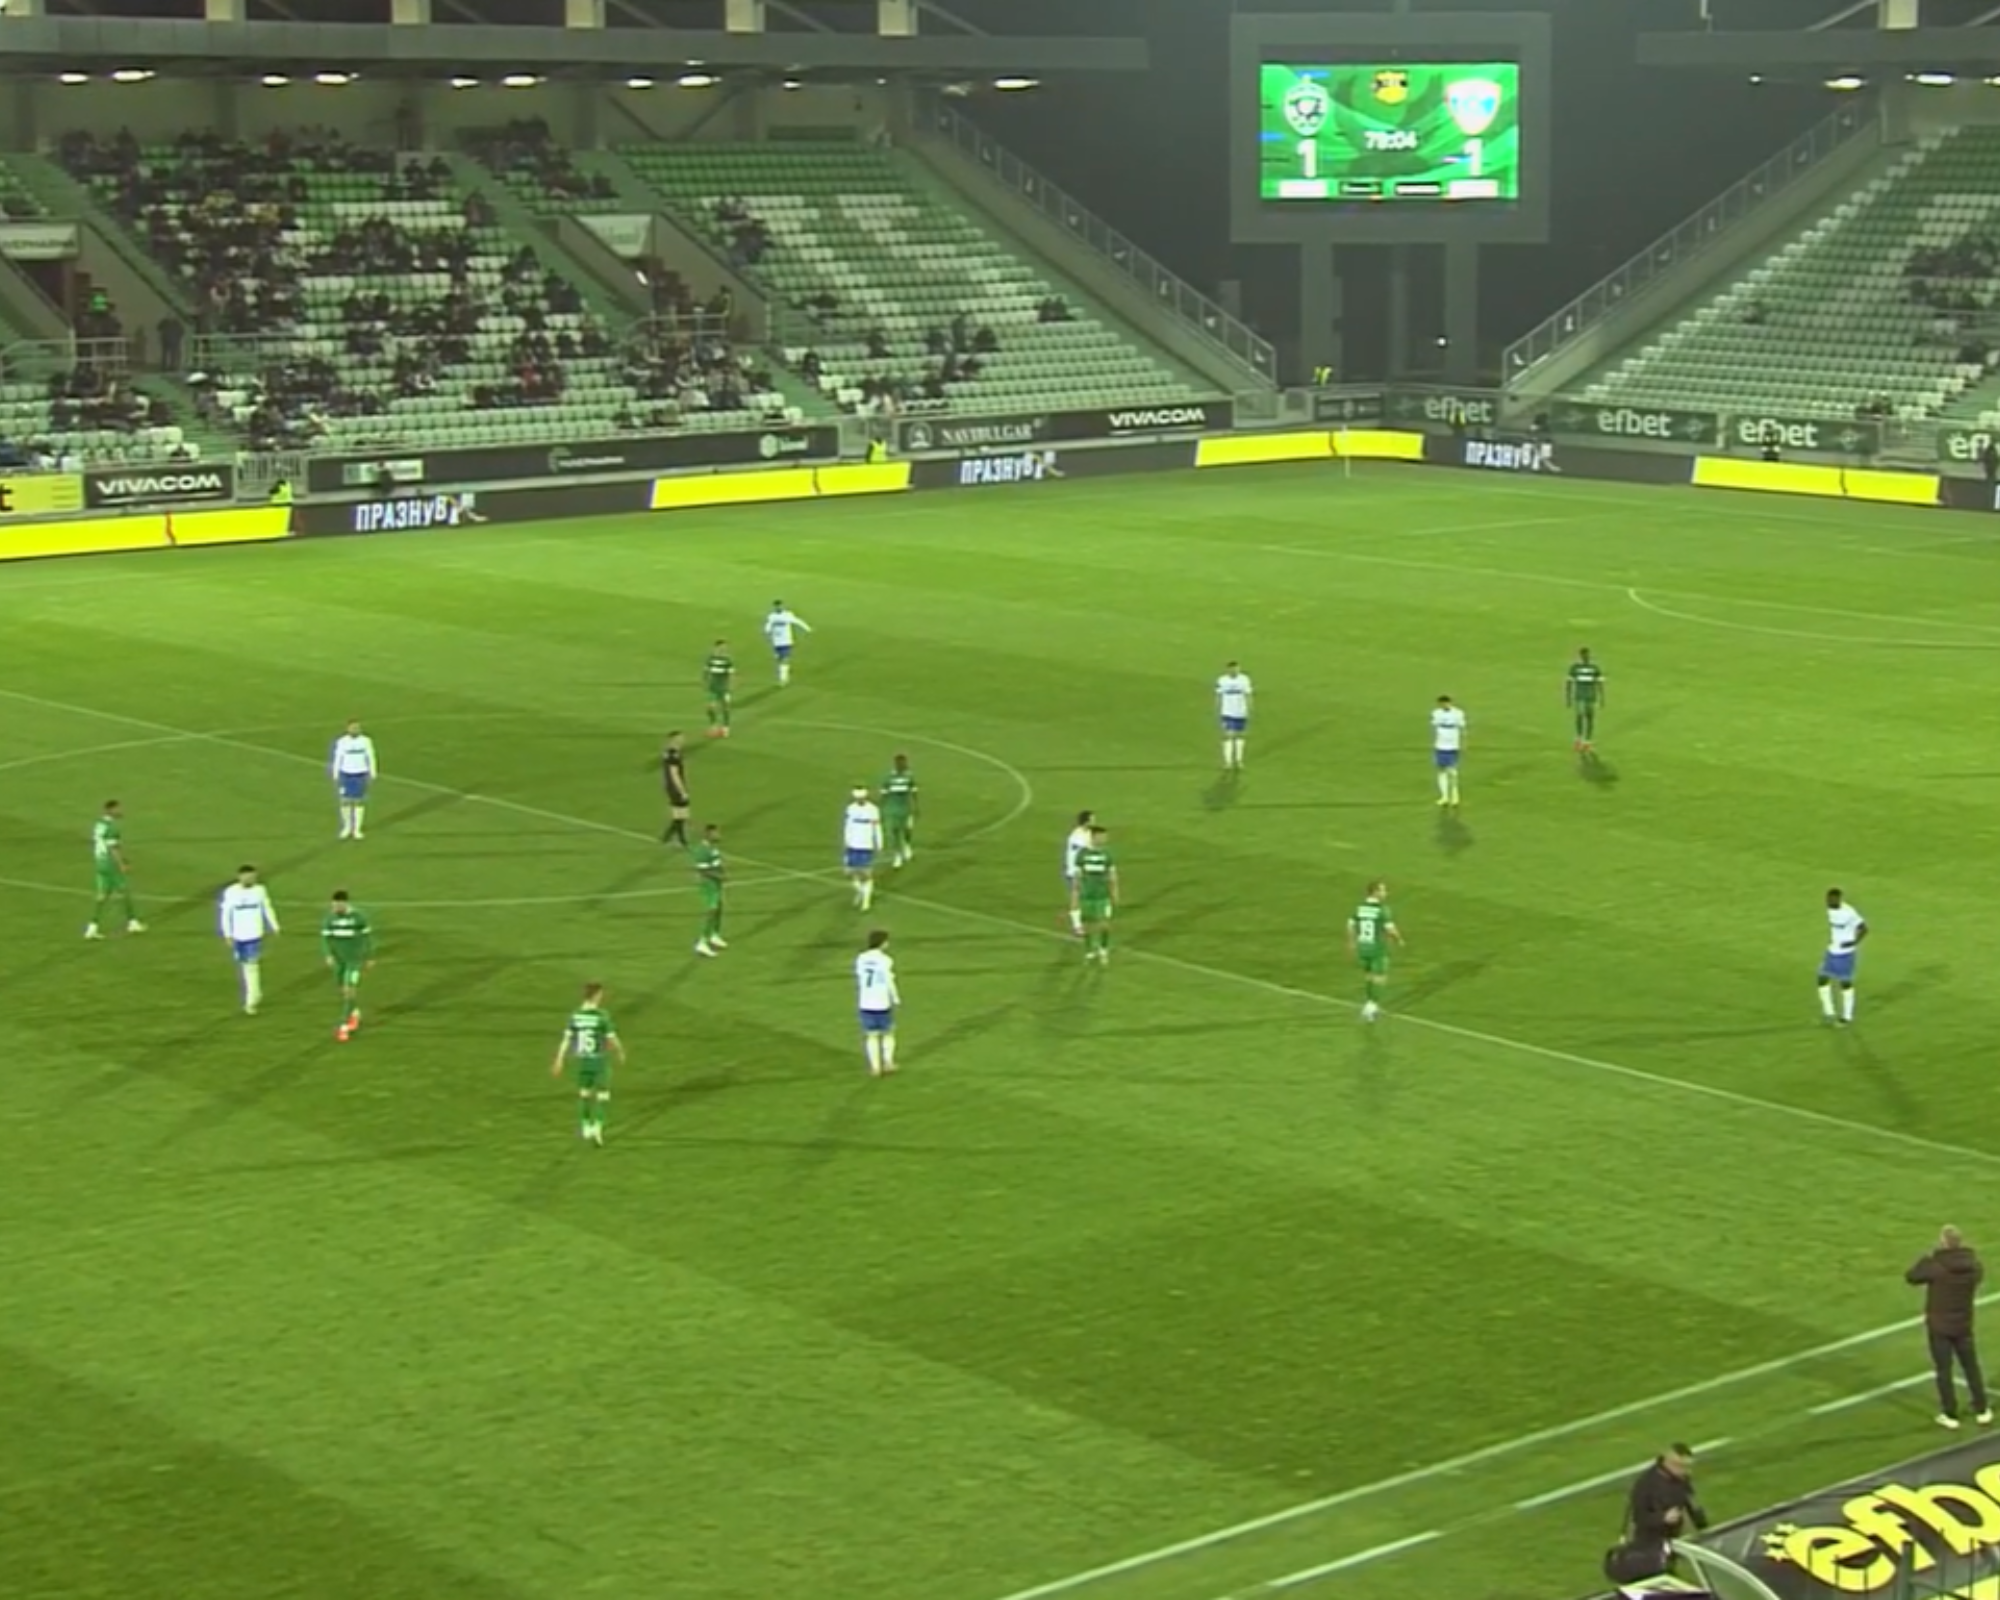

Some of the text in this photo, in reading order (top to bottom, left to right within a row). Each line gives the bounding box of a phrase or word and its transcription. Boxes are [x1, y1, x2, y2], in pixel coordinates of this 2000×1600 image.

[1297, 138, 1317, 178] 1
[1464, 138, 1483, 177] 1
[1108, 407, 1206, 428] VIVACOM
[1597, 408, 1673, 438] efbet
[97, 473, 223, 495] VIVACOM
